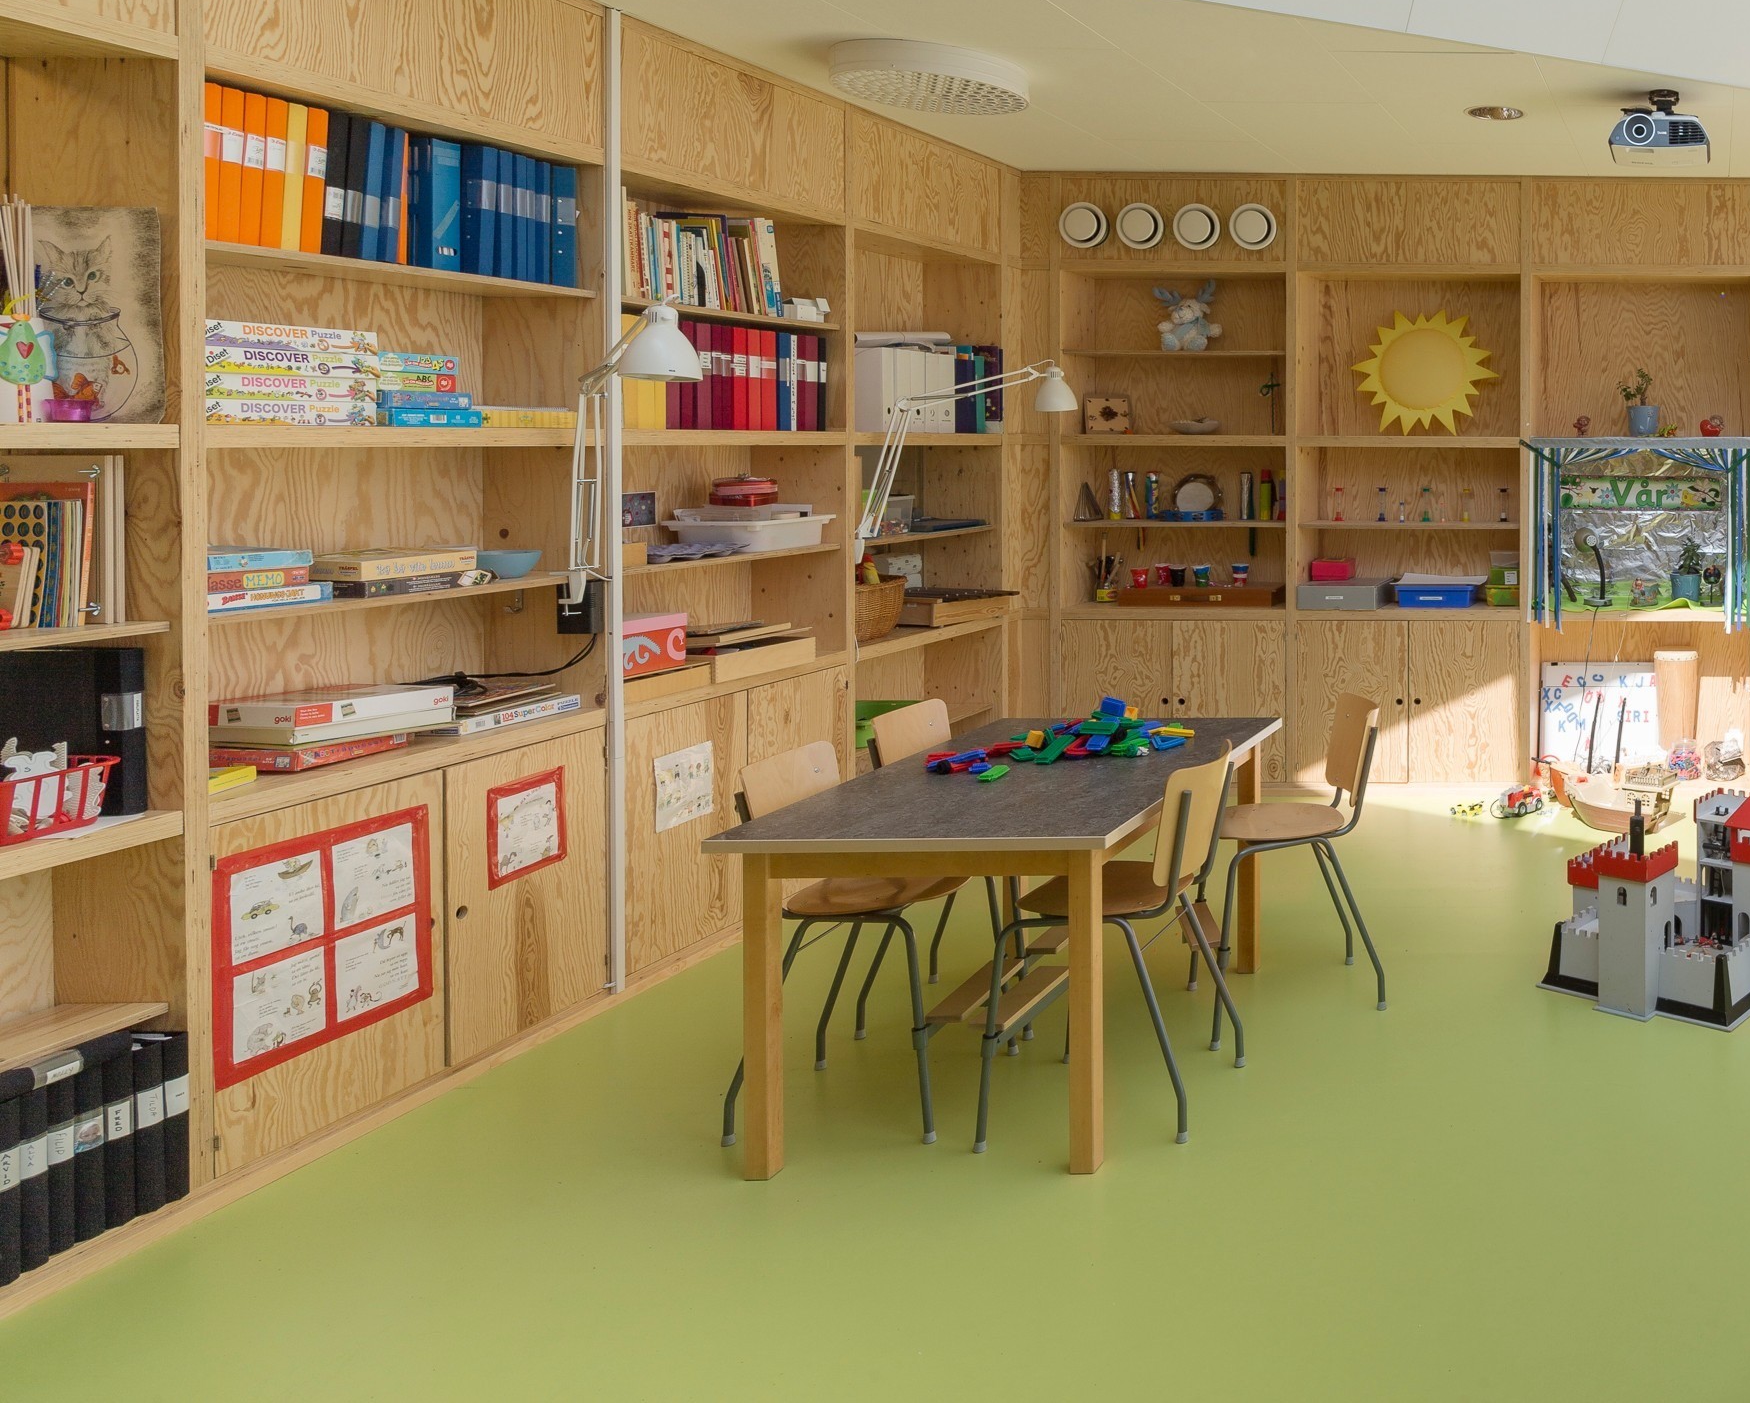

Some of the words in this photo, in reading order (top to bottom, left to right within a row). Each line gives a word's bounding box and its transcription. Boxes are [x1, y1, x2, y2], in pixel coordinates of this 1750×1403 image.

[205, 321, 223, 336] iset
[243, 325, 308, 339] DISCOVER
[311, 330, 342, 340] Puzzle
[206, 348, 229, 364] Diset
[244, 350, 310, 363] DISCOVER
[312, 354, 343, 364] Puzzle
[241, 376, 307, 389] DISCOVER
[309, 379, 341, 389] Puzzle
[240, 402, 306, 415] DISCOVER
[309, 404, 340, 413] Puzzle
[1610, 479, 1669, 507] Vår
[245, 574, 283, 587] MEMO
[1562, 675, 1572, 687] E
[1619, 675, 1628, 688] K
[433, 696, 449, 705] goki
[502, 712, 514, 722] 104
[514, 706, 535, 718] Super
[535, 703, 554, 713] Color
[274, 716, 291, 724] goki
[55, 1132, 68, 1155] FILIP
